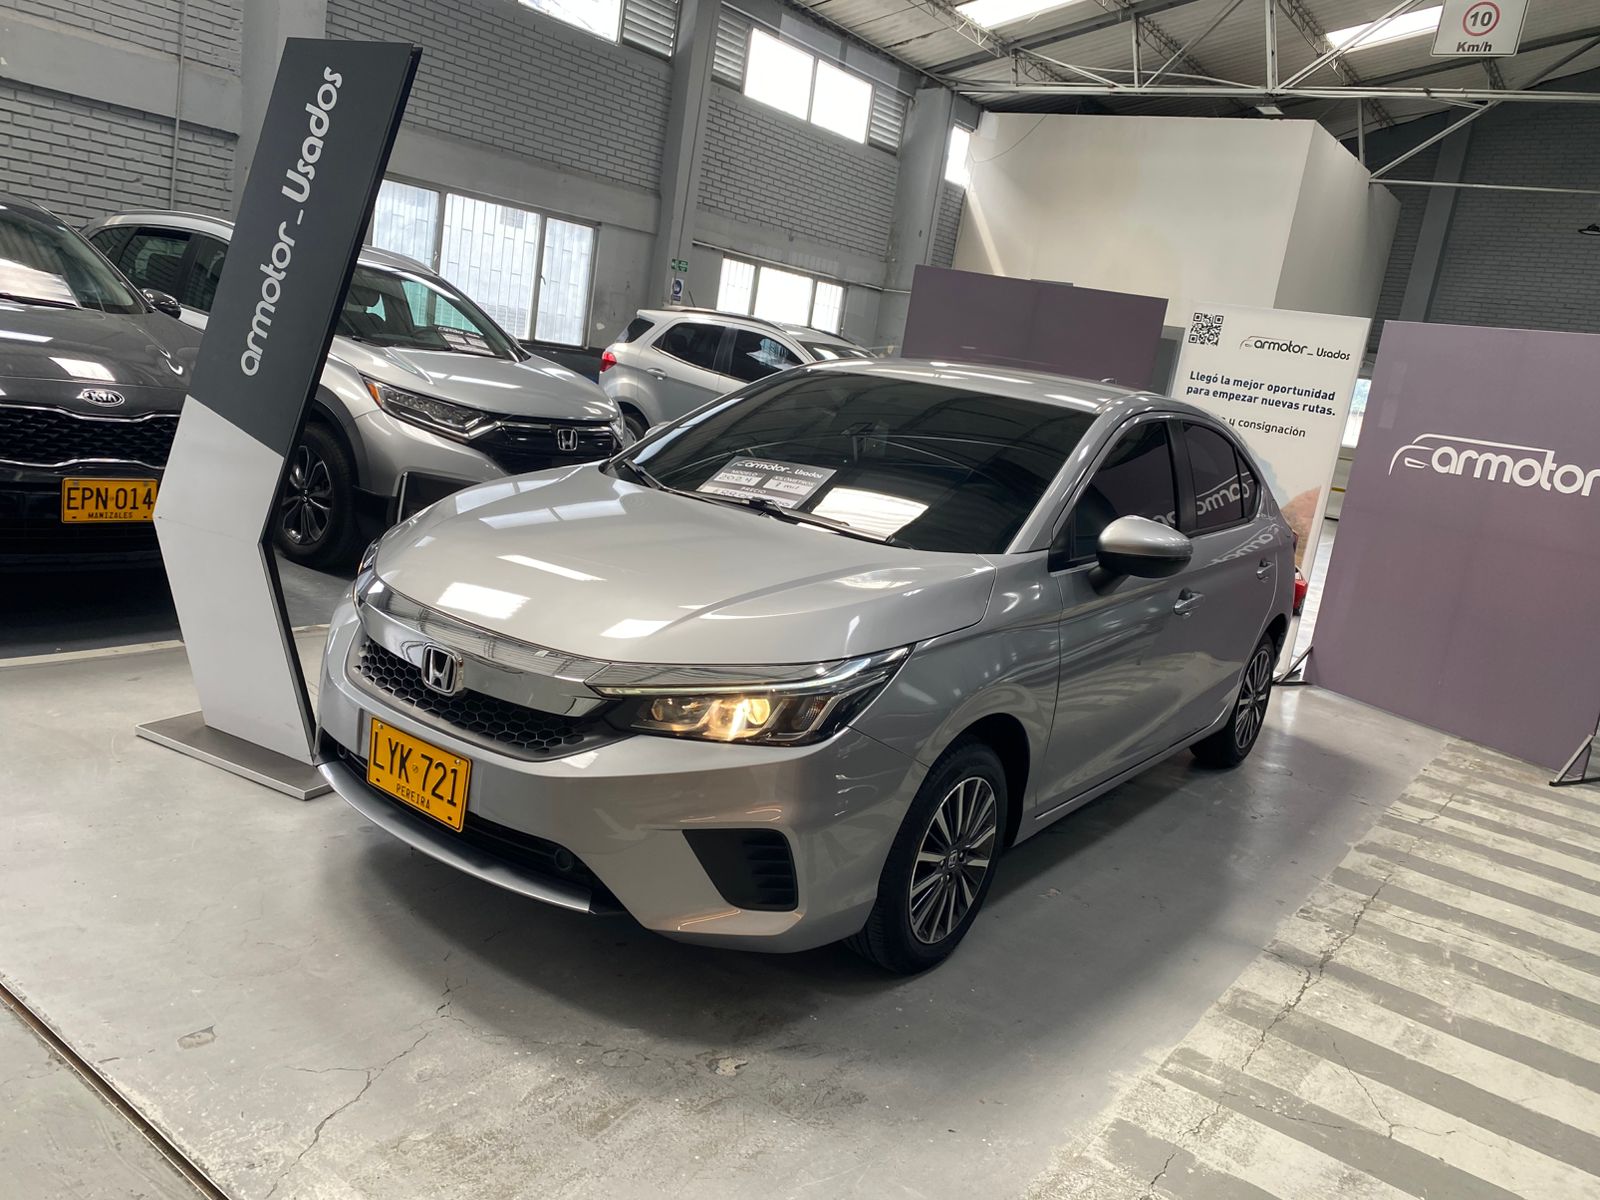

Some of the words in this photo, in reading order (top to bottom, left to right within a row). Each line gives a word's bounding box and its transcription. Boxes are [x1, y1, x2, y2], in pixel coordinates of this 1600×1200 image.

[1470, 11, 1493, 27] 10
[1456, 41, 1492, 52] Km/h
[1316, 347, 1351, 361] Usados
[1189, 371, 1218, 384] Llegó
[1221, 375, 1230, 386] la
[1233, 378, 1265, 391] mejor
[1267, 383, 1336, 401] oportunidad
[1186, 385, 1210, 397] para
[1212, 390, 1259, 405] empezar
[1261, 397, 1300, 410] nuevas
[1302, 403, 1336, 416] rutas.
[1228, 418, 1235, 427] y
[1238, 416, 1306, 438] consignación
[396, 783, 431, 809] PEREIRA
